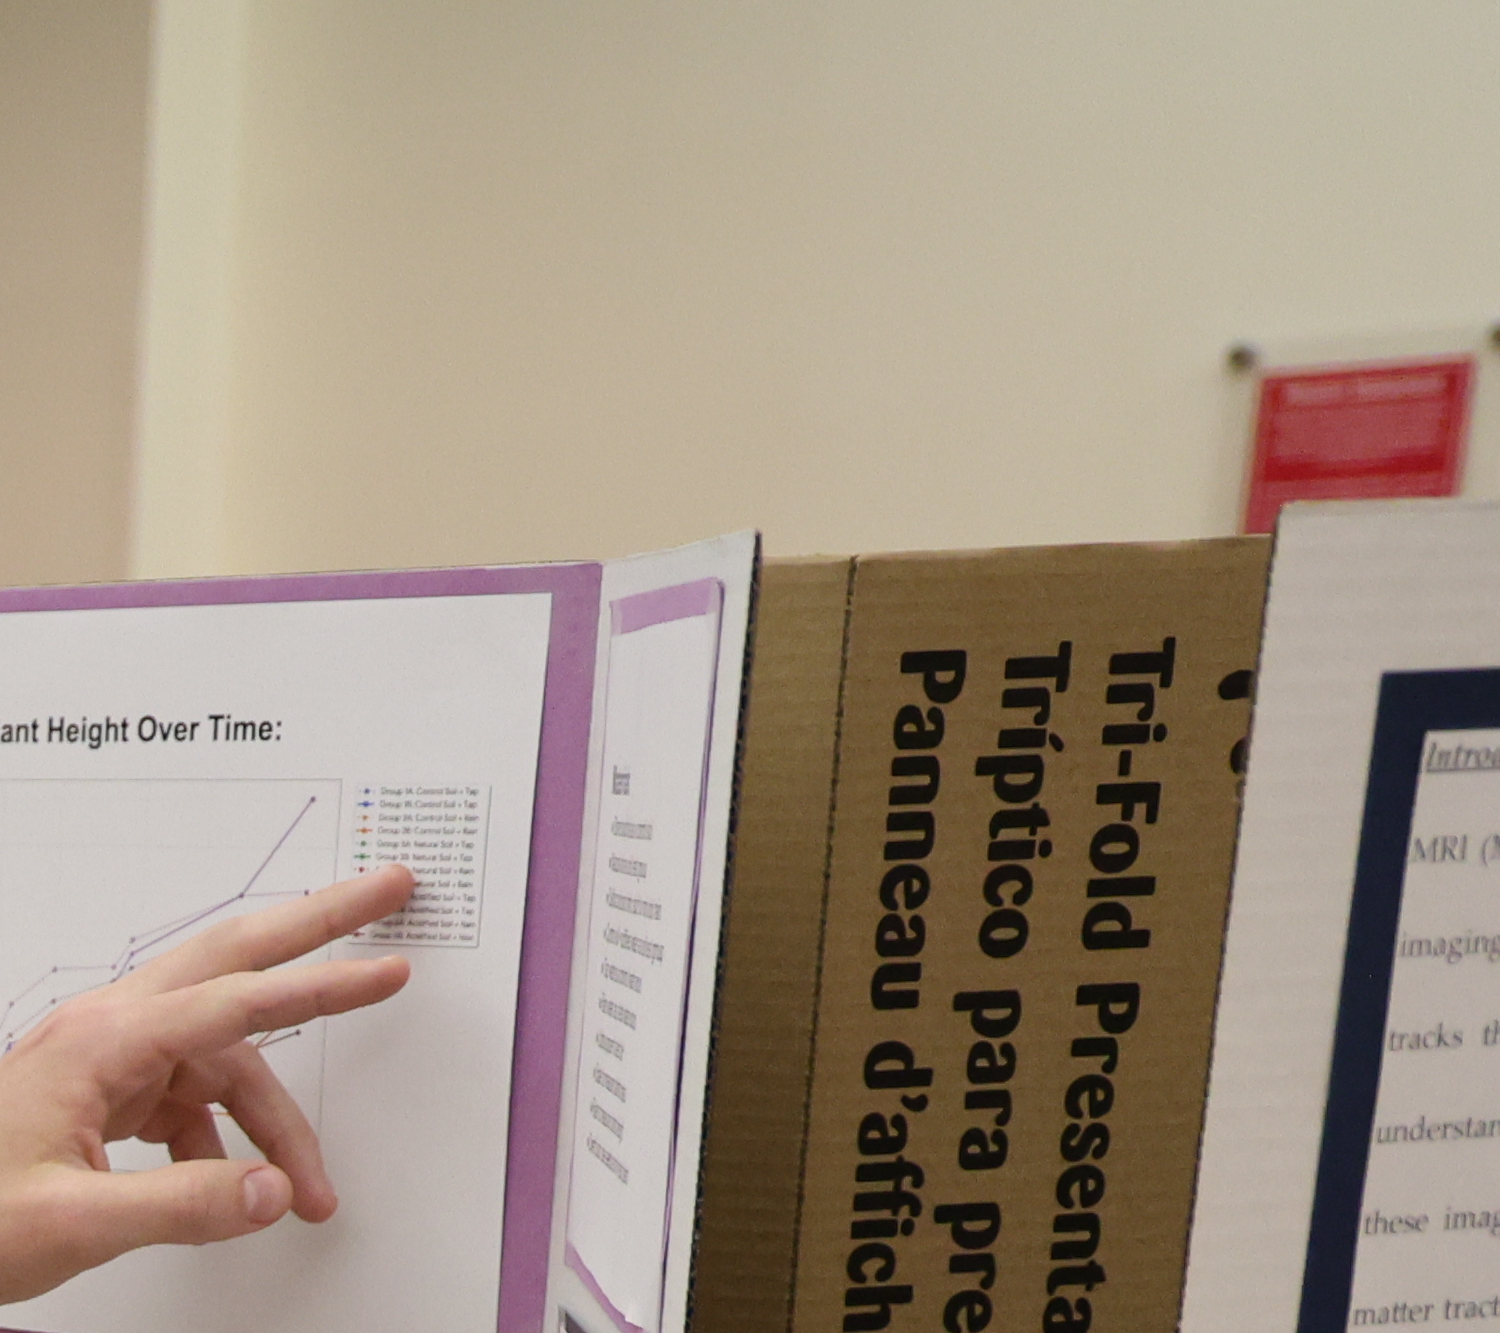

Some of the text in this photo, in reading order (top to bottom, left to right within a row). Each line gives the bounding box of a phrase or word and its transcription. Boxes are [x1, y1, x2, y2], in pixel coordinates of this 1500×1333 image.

[48, 716, 129, 750] Height
[137, 715, 200, 742] Over
[208, 714, 281, 741] Time:
[870, 649, 967, 1011] Panneau
[974, 640, 1073, 959] Tríptico
[1080, 636, 1176, 951] Tri-Fold
[952, 989, 1022, 1171] para
